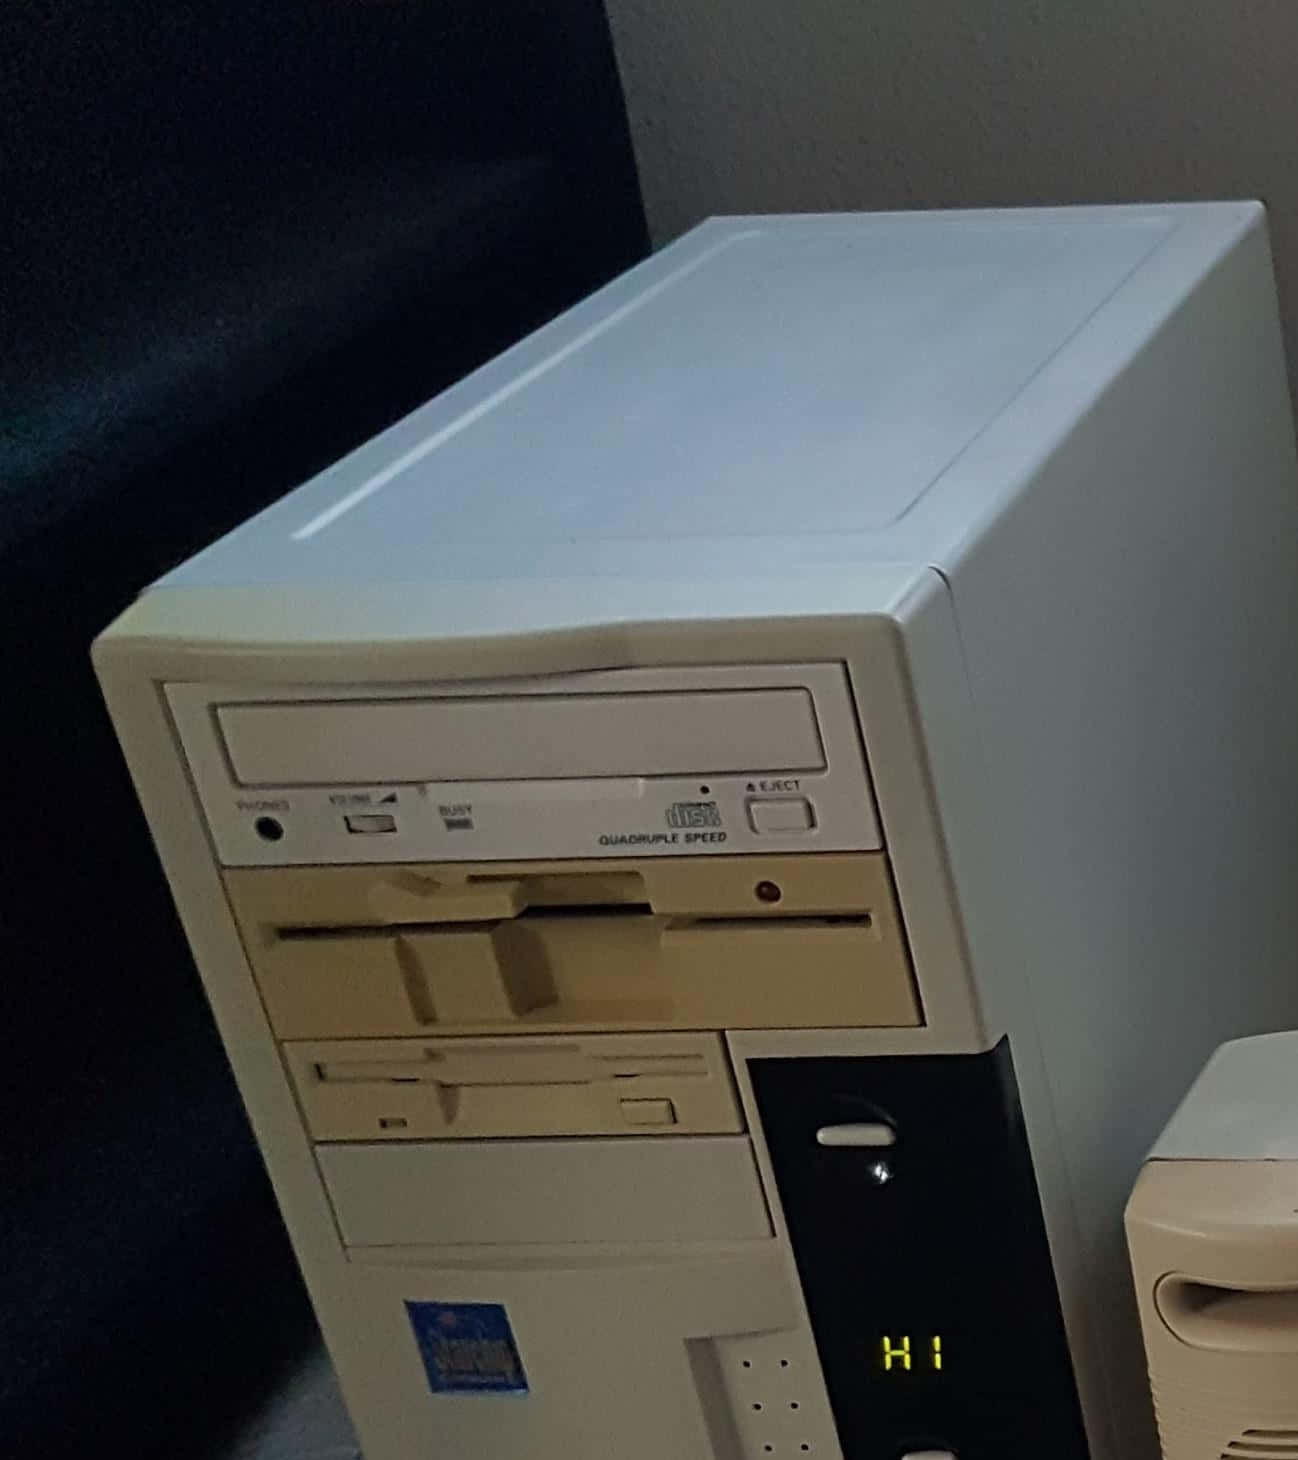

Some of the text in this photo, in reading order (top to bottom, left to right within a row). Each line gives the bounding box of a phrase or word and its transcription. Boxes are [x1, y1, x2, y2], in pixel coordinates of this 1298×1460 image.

[760, 780, 800, 791] EJECT
[597, 832, 727, 846] QUADRUPLE SPEED
